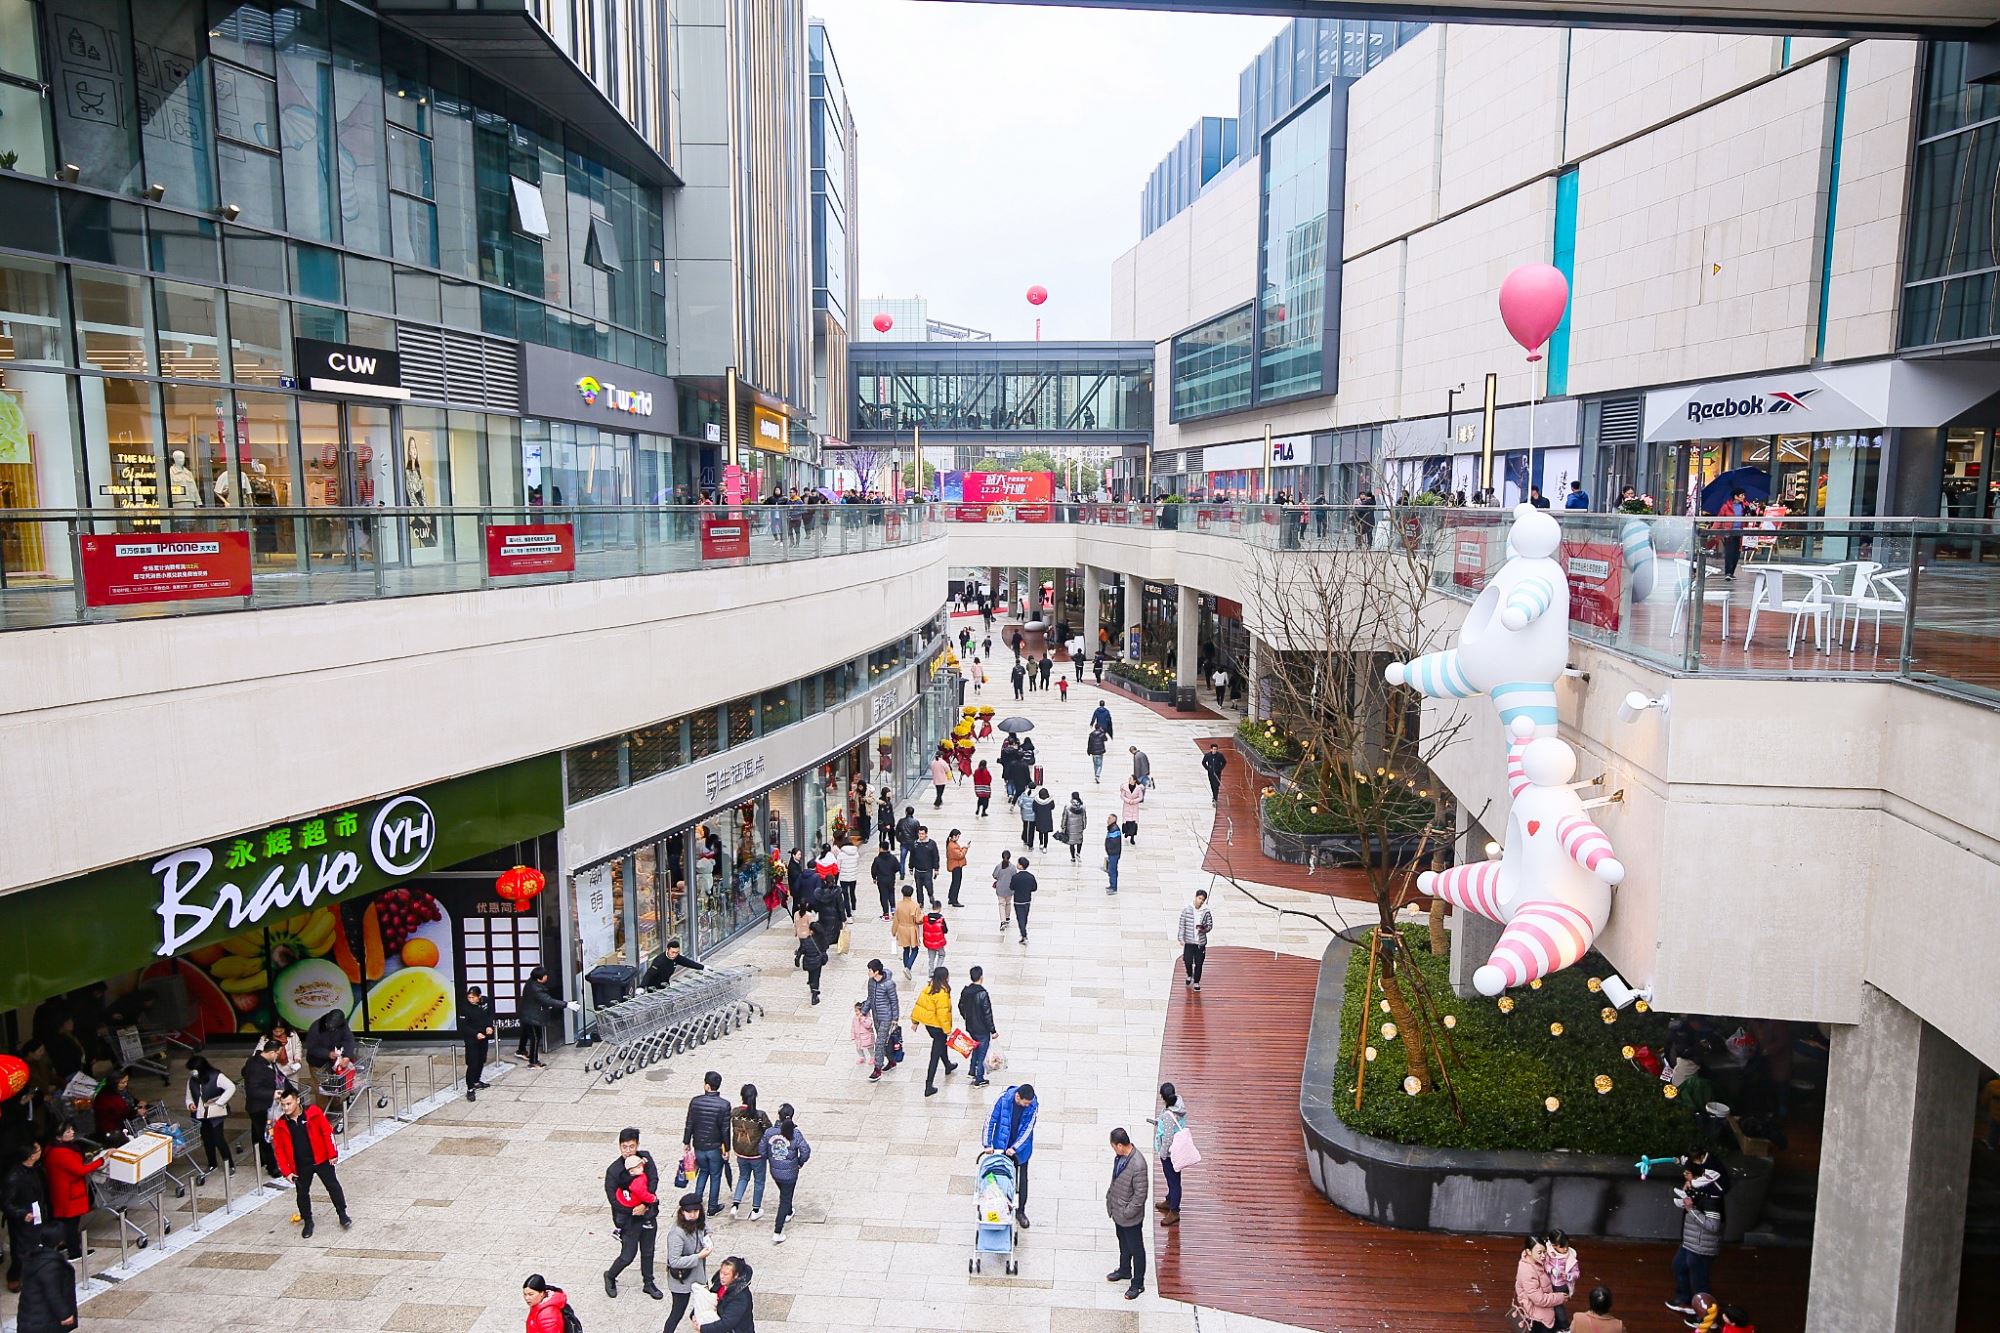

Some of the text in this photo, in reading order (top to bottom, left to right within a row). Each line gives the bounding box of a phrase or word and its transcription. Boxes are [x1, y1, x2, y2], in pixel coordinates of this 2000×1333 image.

[328, 352, 377, 375] CUW
[1688, 395, 1764, 423] Reebok
[1273, 442, 1294, 461] FILA
[157, 543, 198, 553] iPhone
[225, 812, 358, 870] 永辉超市
[152, 847, 363, 956] Bravo
[476, 902, 525, 914] 优惠简
